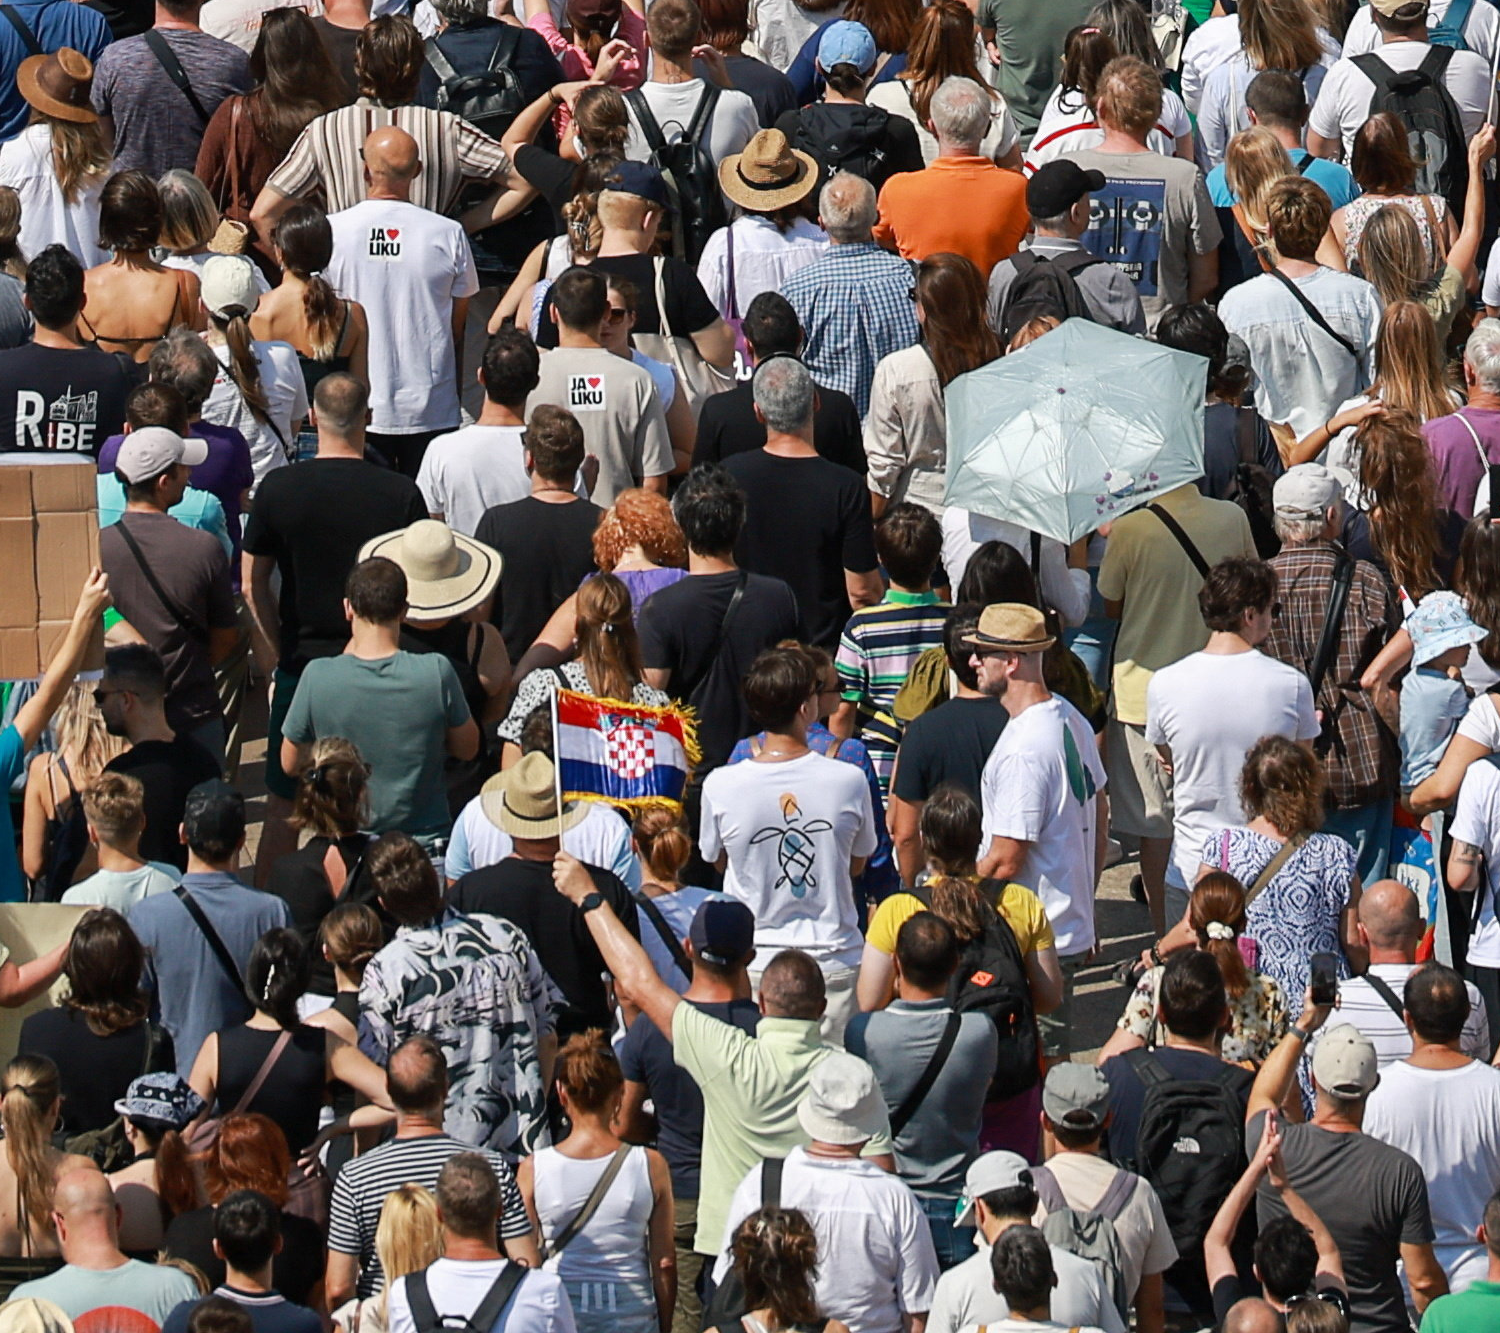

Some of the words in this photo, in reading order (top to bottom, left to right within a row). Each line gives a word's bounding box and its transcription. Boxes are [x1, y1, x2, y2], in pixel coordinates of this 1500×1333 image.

[368, 227, 385, 243] JA
[367, 241, 402, 259] LIKU
[568, 376, 585, 392] JA
[568, 390, 604, 407] LIKU
